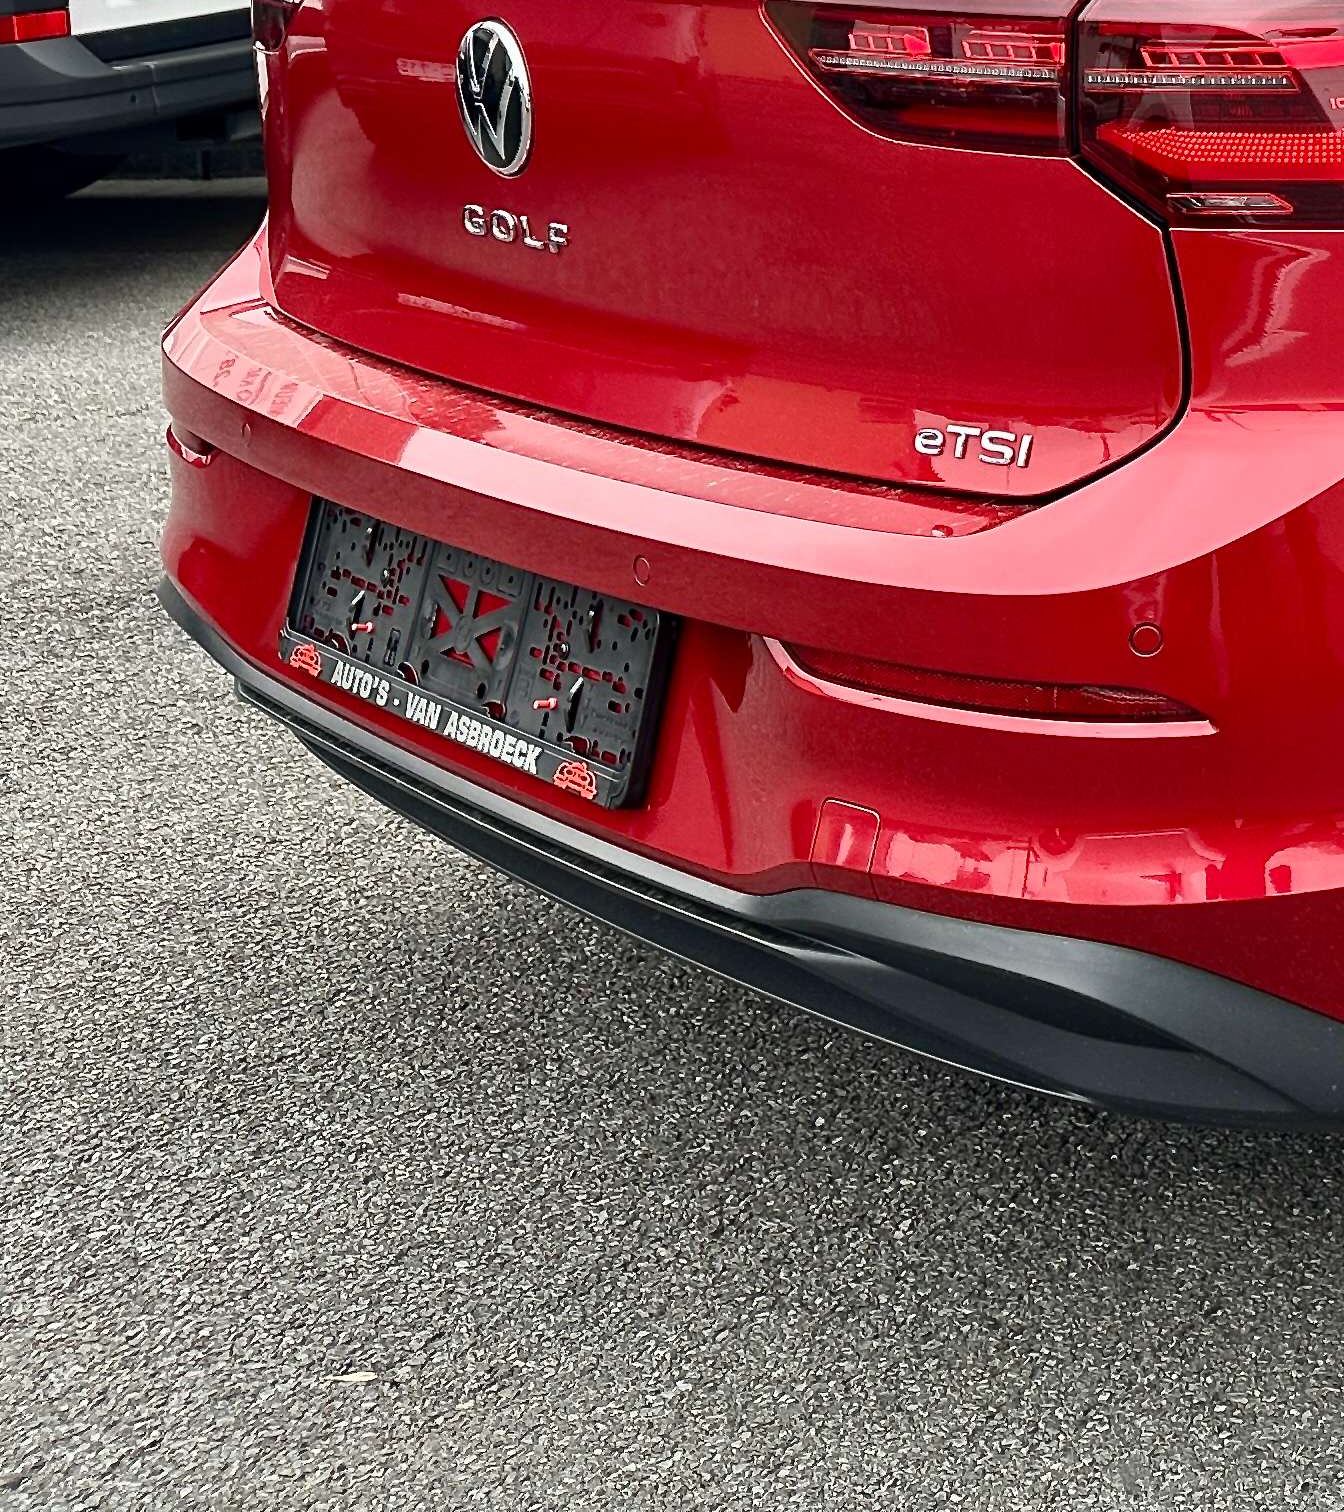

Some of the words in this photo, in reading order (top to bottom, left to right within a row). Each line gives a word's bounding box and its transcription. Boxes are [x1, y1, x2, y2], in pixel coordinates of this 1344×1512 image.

[463, 203, 569, 254] GOLF
[914, 424, 1034, 468] eTSI
[330, 659, 390, 706] AUTO'S
[405, 691, 442, 732] VAN
[444, 711, 542, 775] ASBROECK
